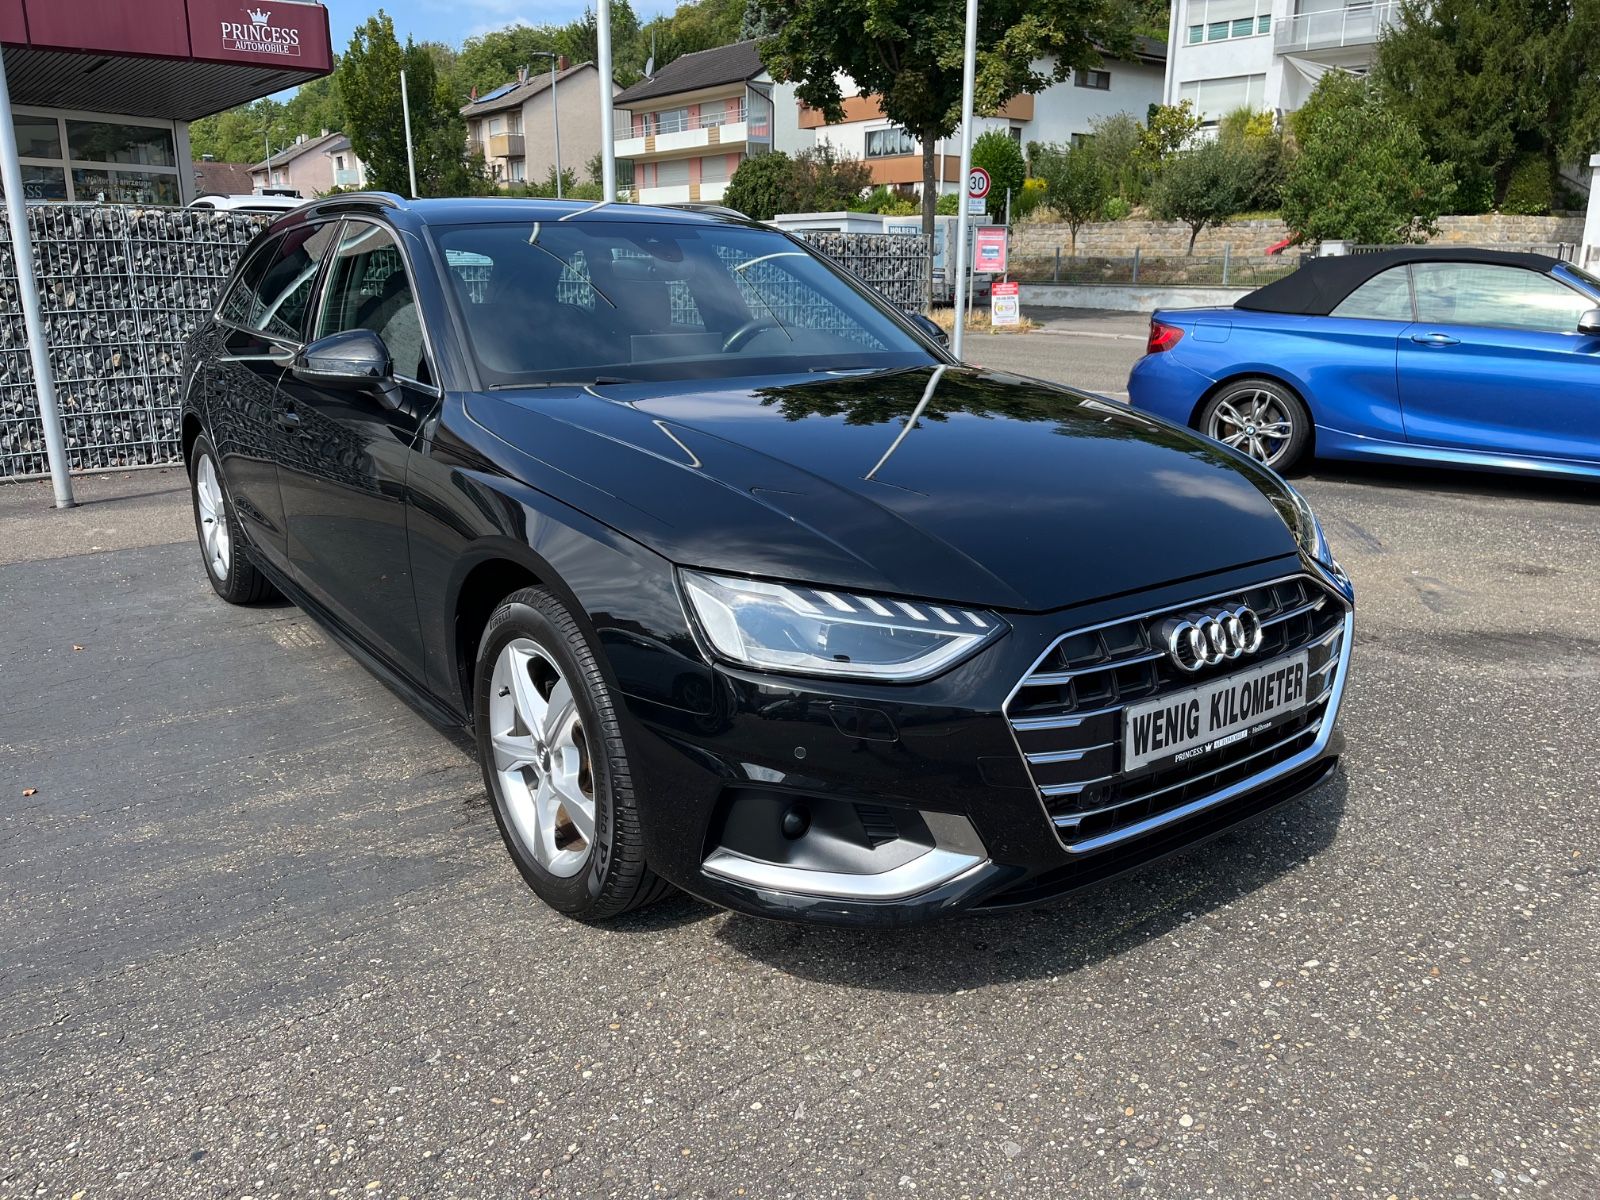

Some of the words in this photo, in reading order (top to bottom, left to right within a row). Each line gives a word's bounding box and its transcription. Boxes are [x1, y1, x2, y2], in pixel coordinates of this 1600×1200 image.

[221, 22, 299, 45] PRINCESS
[235, 40, 290, 54] AUTOMOBILE
[970, 176, 985, 190] 30
[1133, 698, 1200, 757] WENIG
[1208, 662, 1304, 732] KILOMETER
[1175, 746, 1203, 763] PRINCESS
[594, 840, 609, 885] P7
